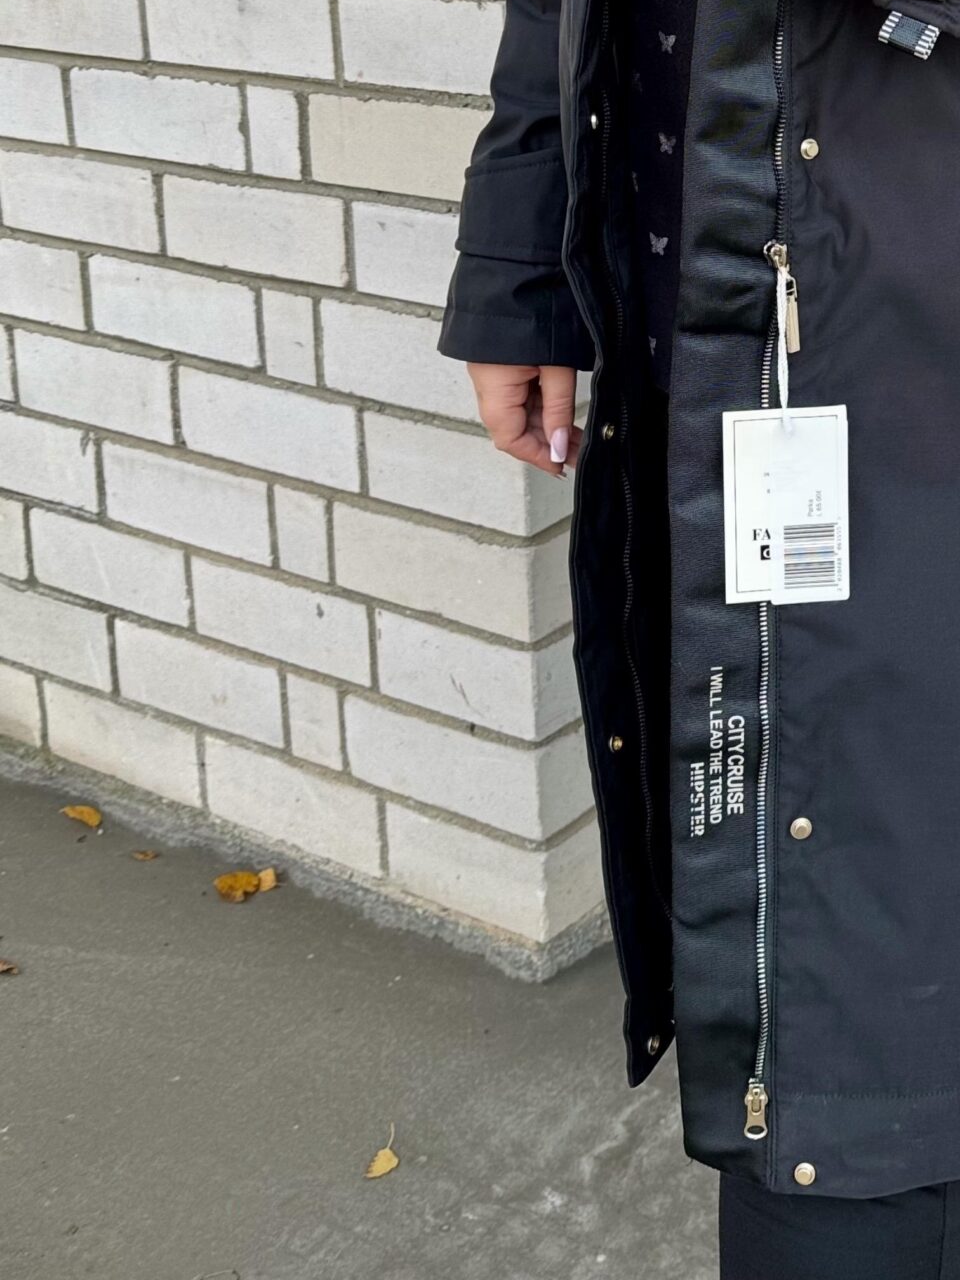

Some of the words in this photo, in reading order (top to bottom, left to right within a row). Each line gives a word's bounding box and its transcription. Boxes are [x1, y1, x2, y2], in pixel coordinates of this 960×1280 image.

[709, 673, 723, 707] WILL
[709, 709, 723, 749] LEAD
[727, 715, 745, 754] CITY
[709, 750, 723, 775] THE
[690, 762, 705, 838] HIPSTER
[709, 776, 723, 825] TREND
[726, 755, 745, 815] CRUISE
